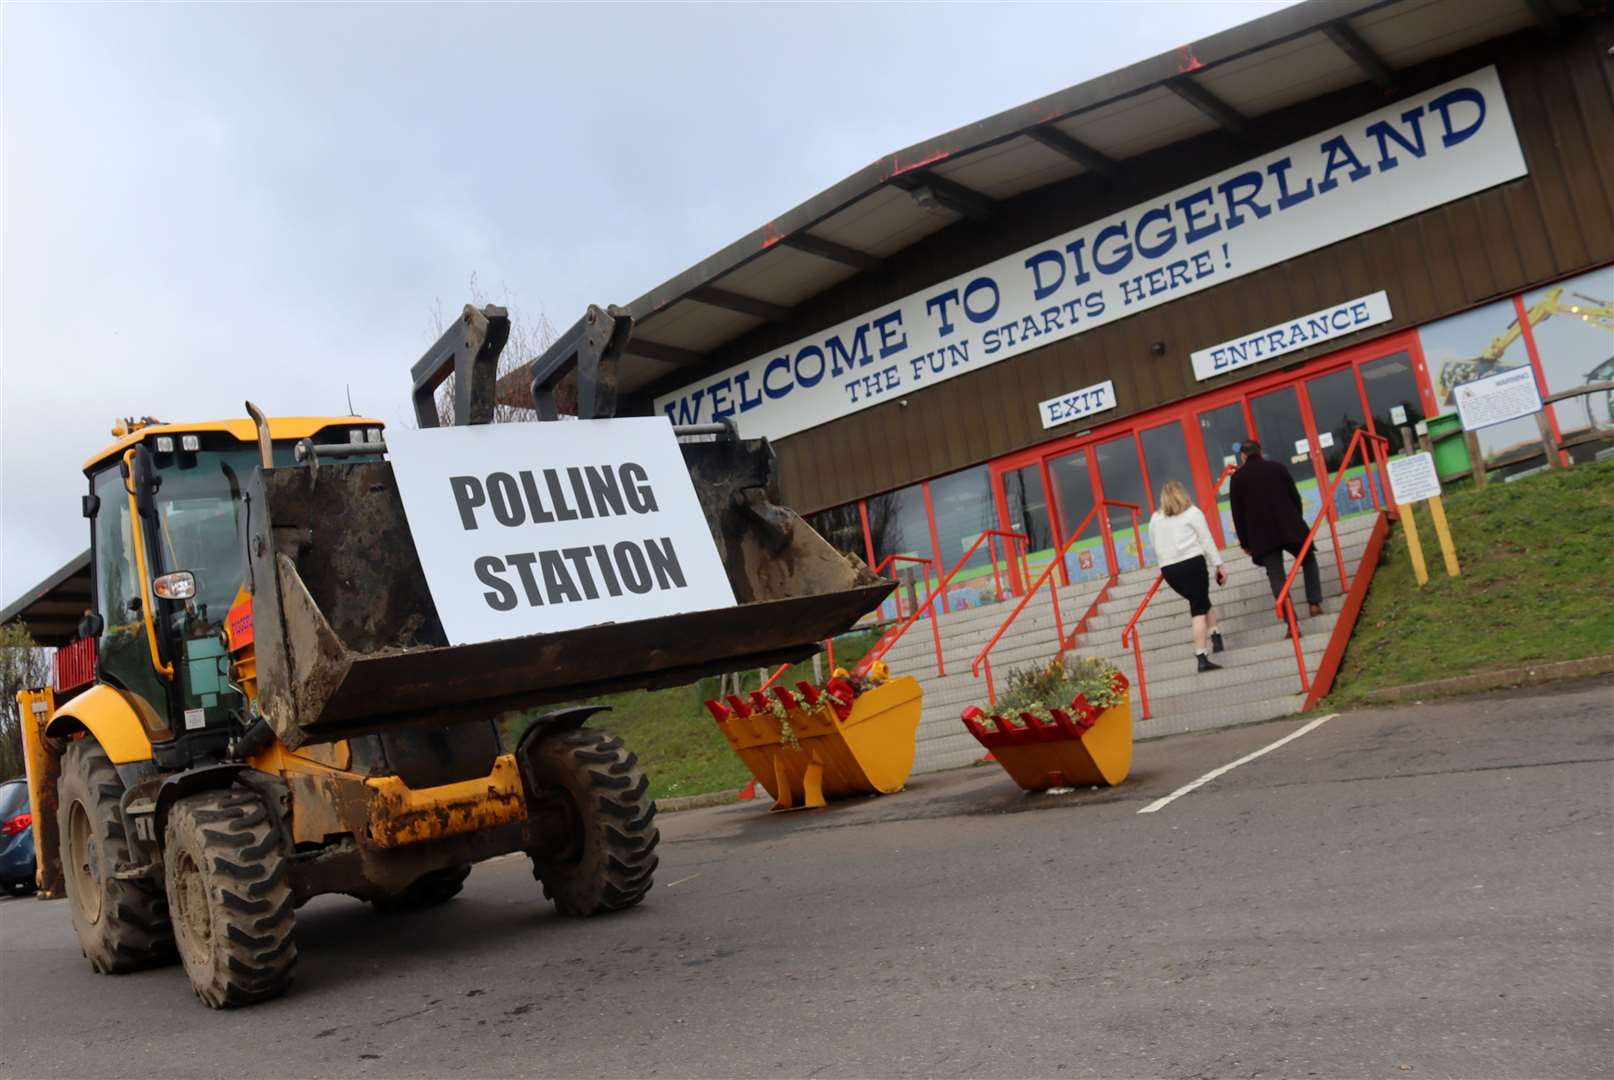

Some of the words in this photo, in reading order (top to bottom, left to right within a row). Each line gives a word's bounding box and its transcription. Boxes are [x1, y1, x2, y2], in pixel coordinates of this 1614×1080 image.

[664, 309, 907, 425] WELCOME
[928, 276, 1000, 338] TO
[1024, 87, 1487, 300] DIGGERLAND
[845, 365, 900, 403] THE
[912, 340, 970, 381] FUN
[982, 290, 1106, 354] STARTS
[1210, 302, 1370, 370] ENTRANCE
[1047, 387, 1106, 422] EXIT
[449, 462, 659, 530] POLLING
[473, 537, 688, 612] STATION
